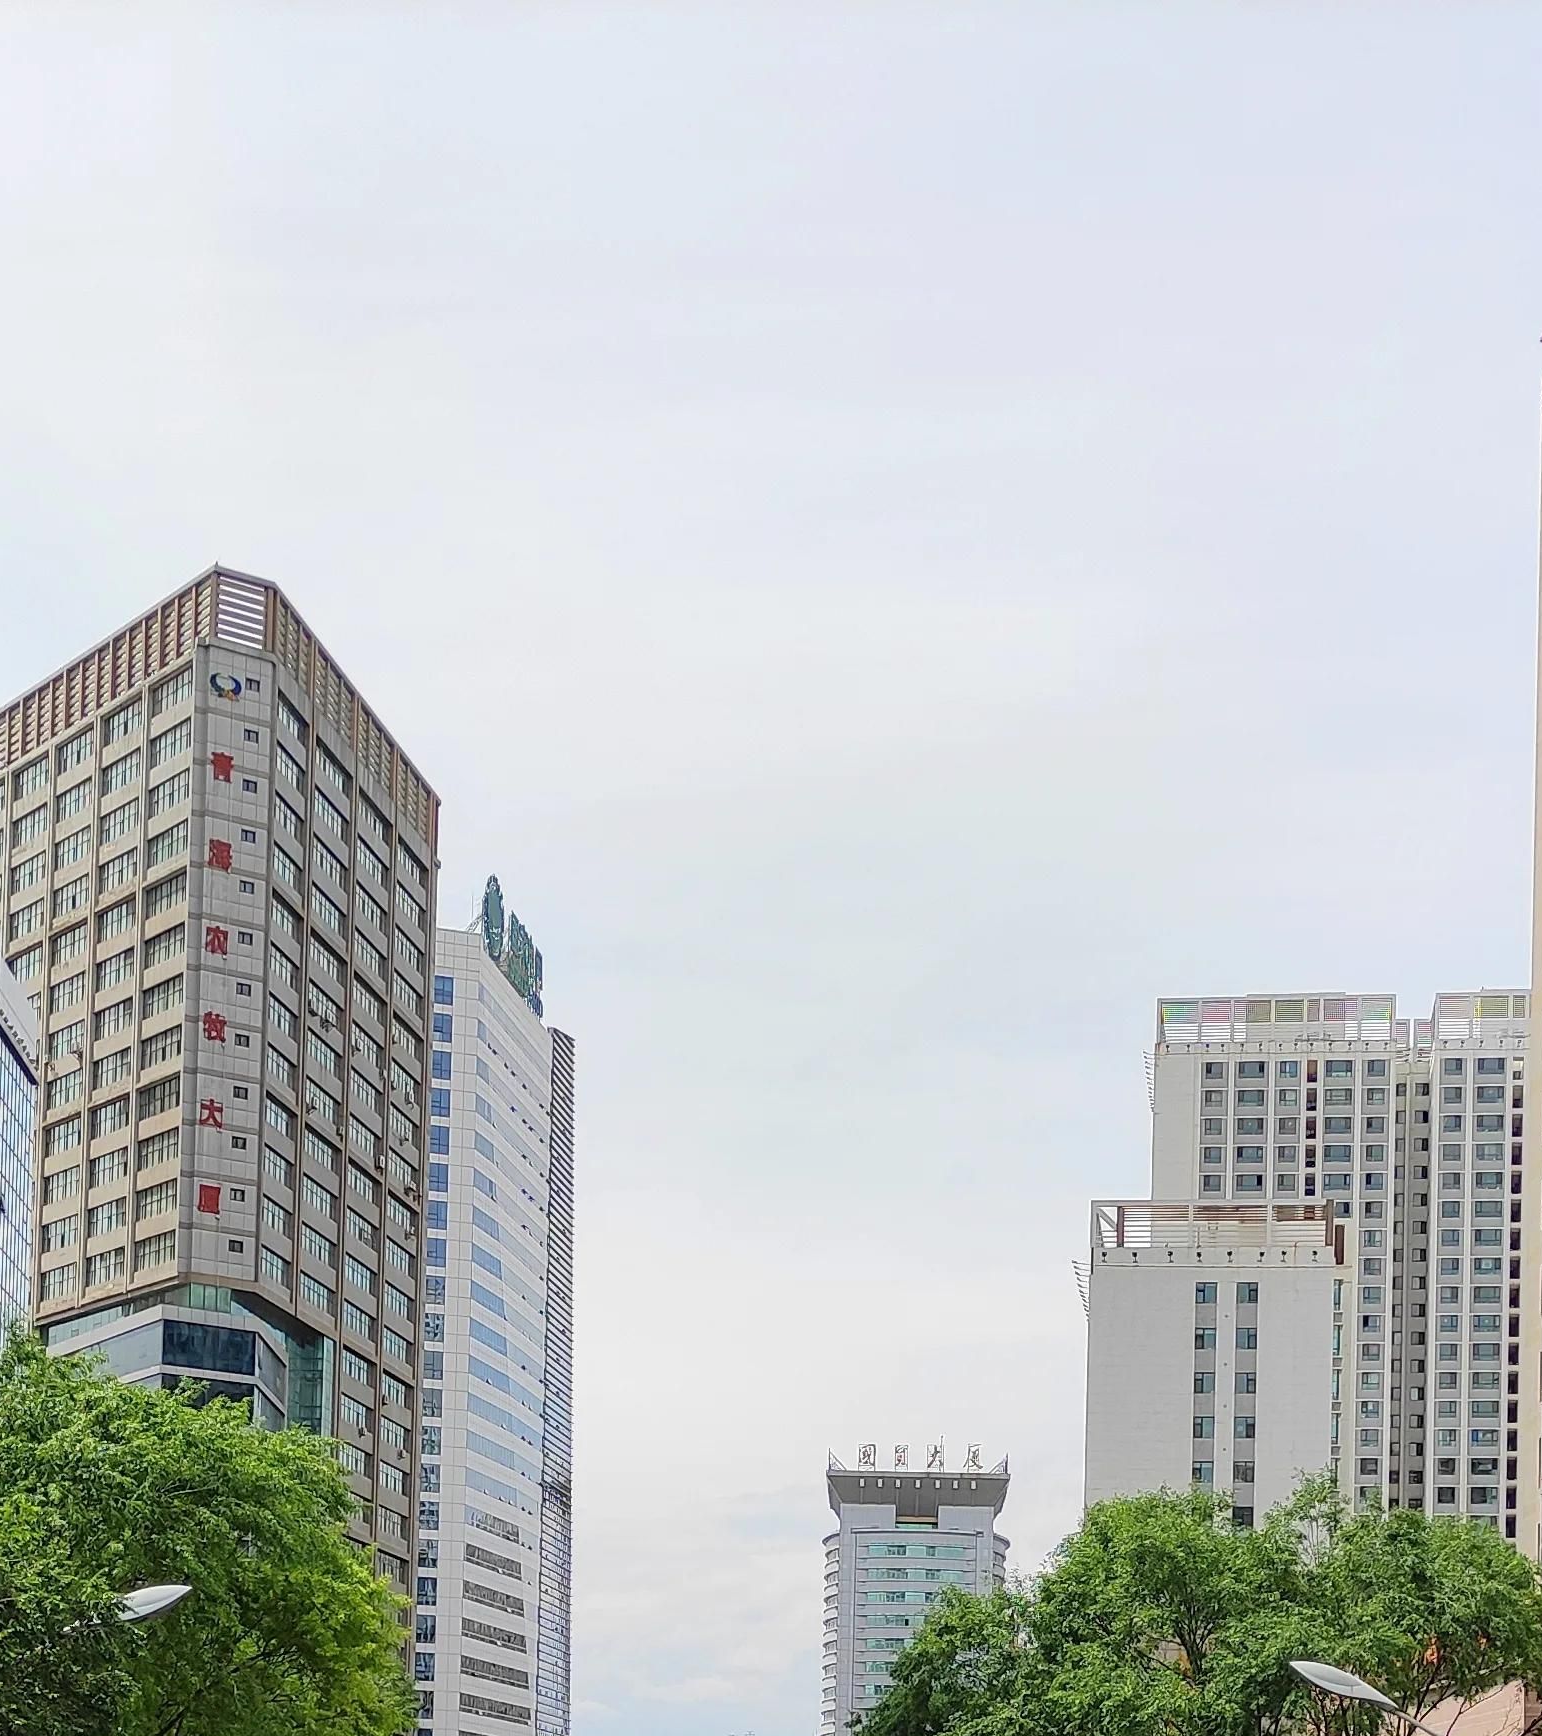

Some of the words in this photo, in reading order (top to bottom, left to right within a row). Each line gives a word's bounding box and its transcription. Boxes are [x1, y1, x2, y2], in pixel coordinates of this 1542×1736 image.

[199, 752, 233, 1215] 青海农牧大厦
